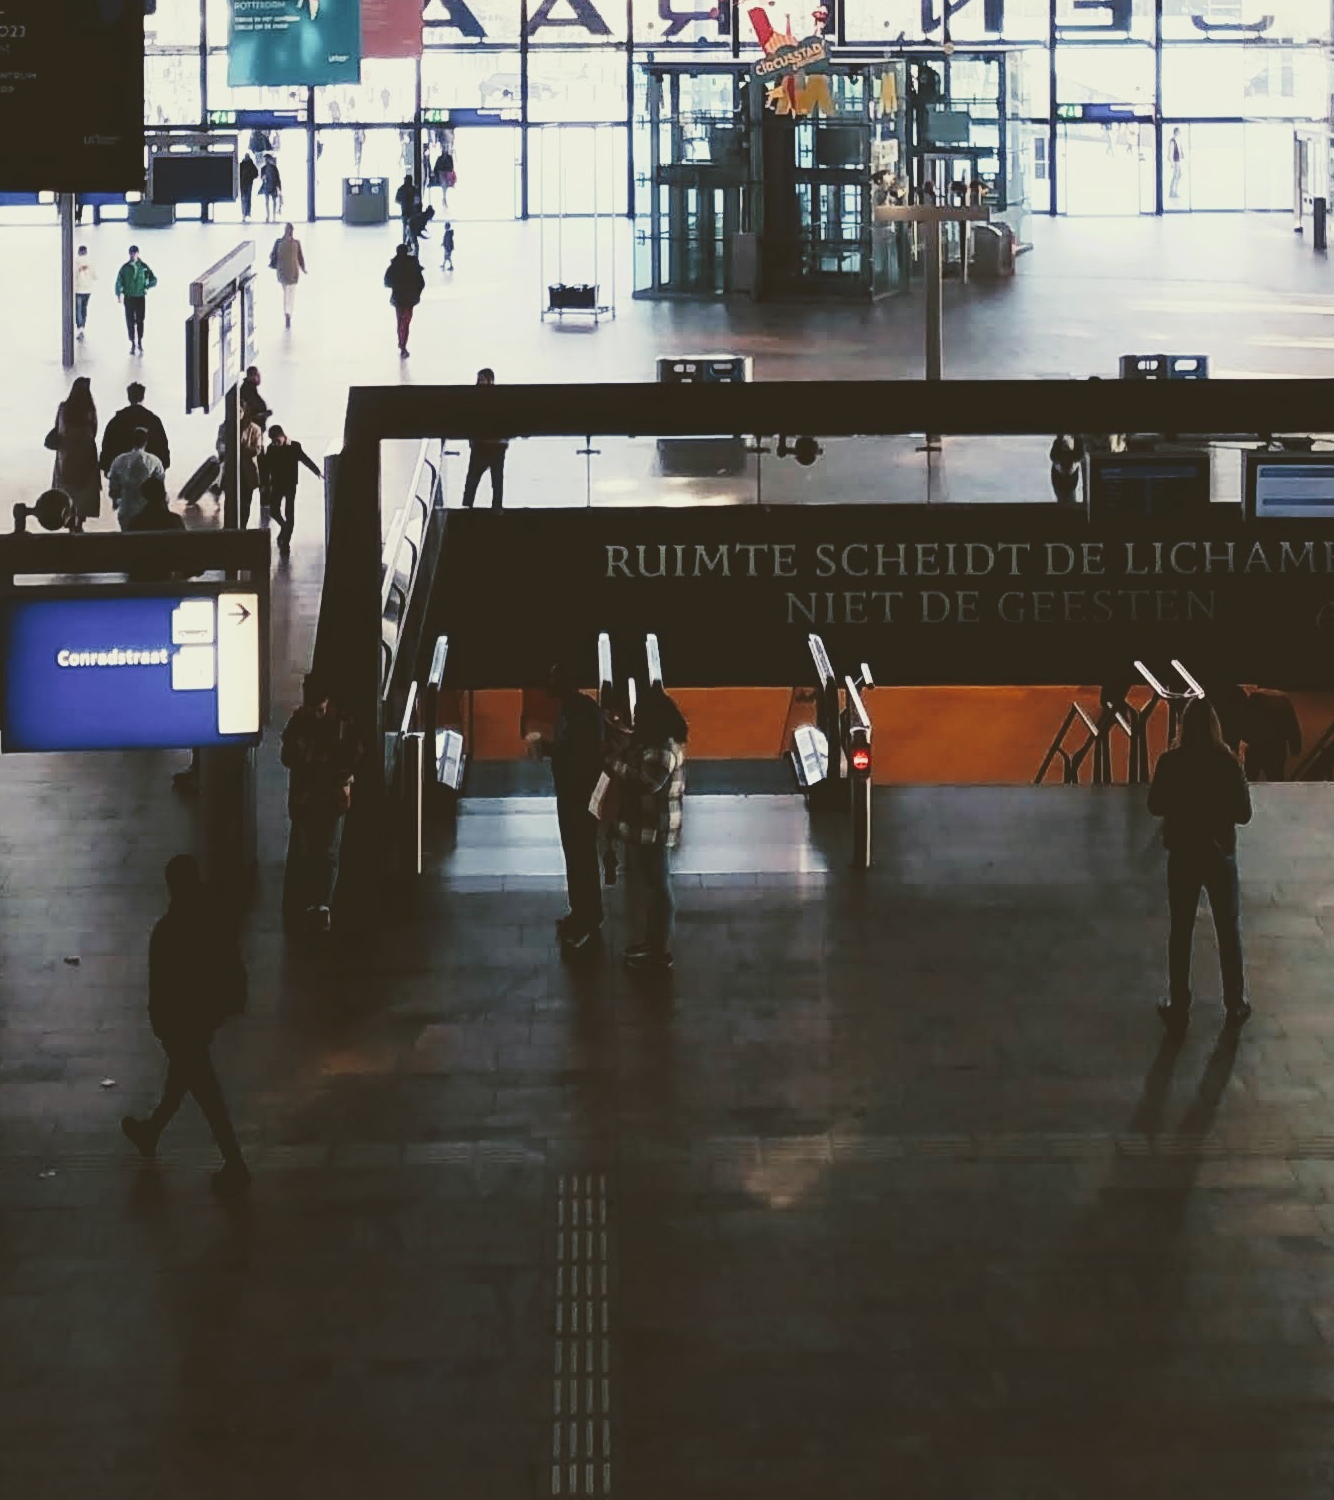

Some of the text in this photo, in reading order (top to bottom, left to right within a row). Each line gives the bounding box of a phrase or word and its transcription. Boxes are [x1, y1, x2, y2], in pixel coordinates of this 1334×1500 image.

[604, 542, 798, 578] RUIMTE
[815, 541, 1031, 577] SCHEIDT
[1044, 541, 1106, 576] DE
[785, 589, 1216, 624] NIET DE GEESTEN
[56, 647, 169, 668] Conradstraat
